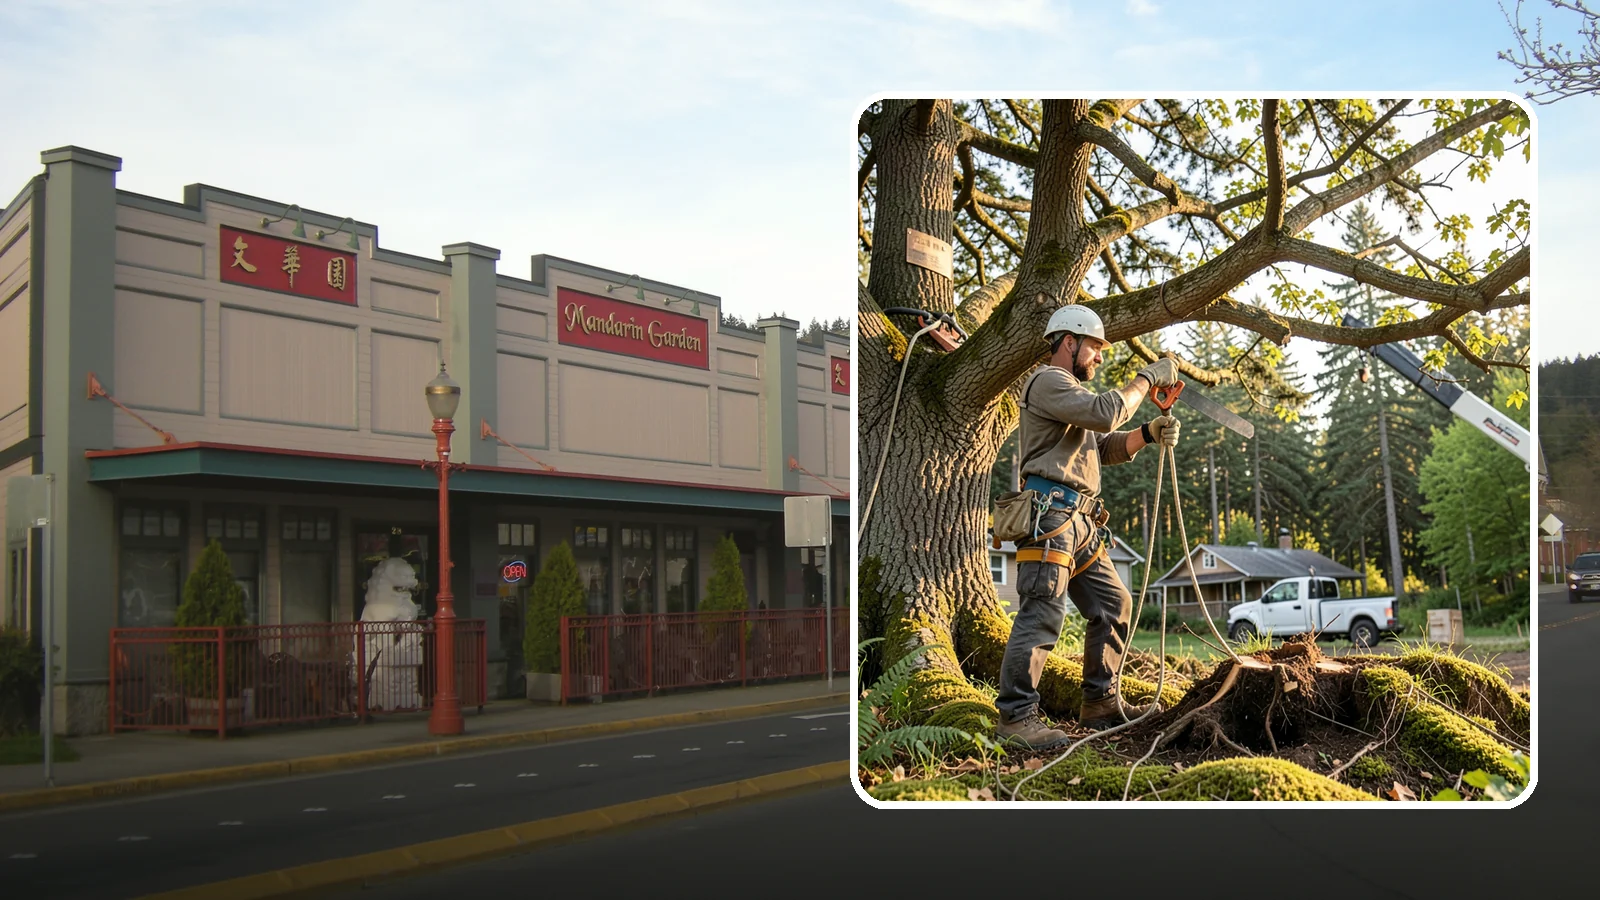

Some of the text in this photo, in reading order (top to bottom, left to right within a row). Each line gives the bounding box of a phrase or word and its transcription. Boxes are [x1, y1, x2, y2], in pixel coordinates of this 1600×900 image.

[231, 235, 346, 291] 文華園
[564, 302, 702, 352] Mandarin Garden
[503, 565, 527, 578] OPEN
